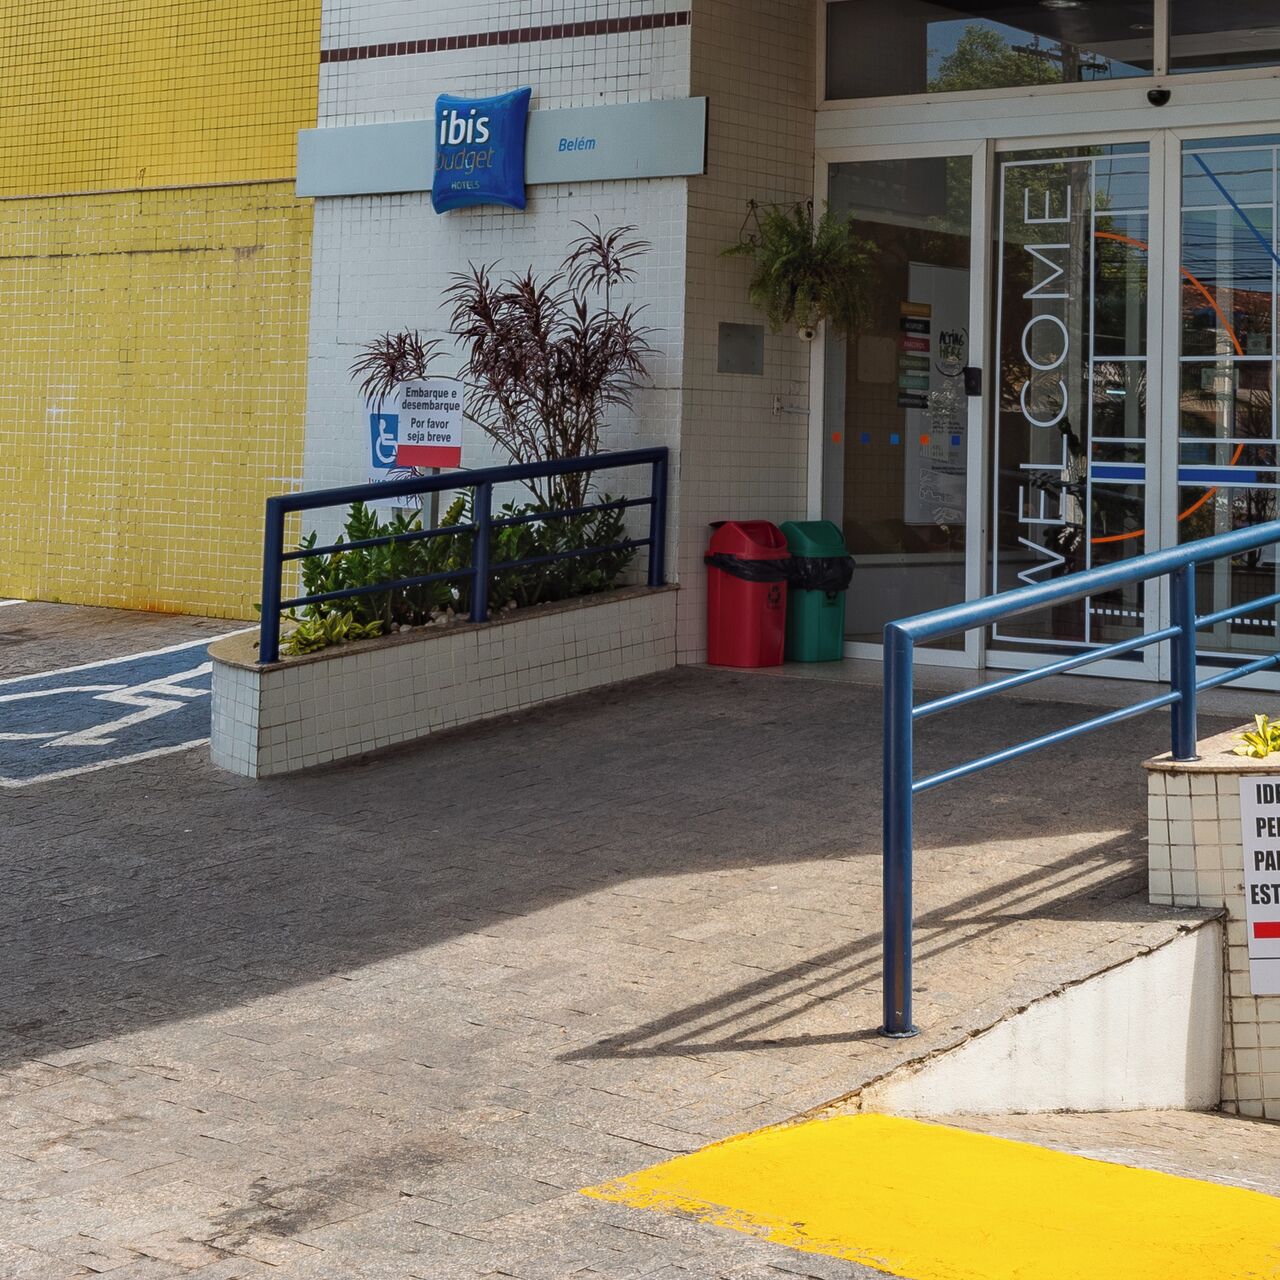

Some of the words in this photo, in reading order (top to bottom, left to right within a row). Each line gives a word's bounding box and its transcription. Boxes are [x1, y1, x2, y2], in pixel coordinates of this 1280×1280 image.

[440, 108, 490, 145] ibis
[558, 137, 596, 152] Belém
[435, 147, 495, 175] budget
[451, 180, 480, 190] HOTELS
[406, 387, 448, 400] Embarque
[451, 390, 457, 398] e
[402, 399, 460, 413] desembarque
[411, 418, 425, 428] Por
[427, 418, 449, 429] favor
[407, 431, 425, 443] seja
[428, 431, 451, 442] breve
